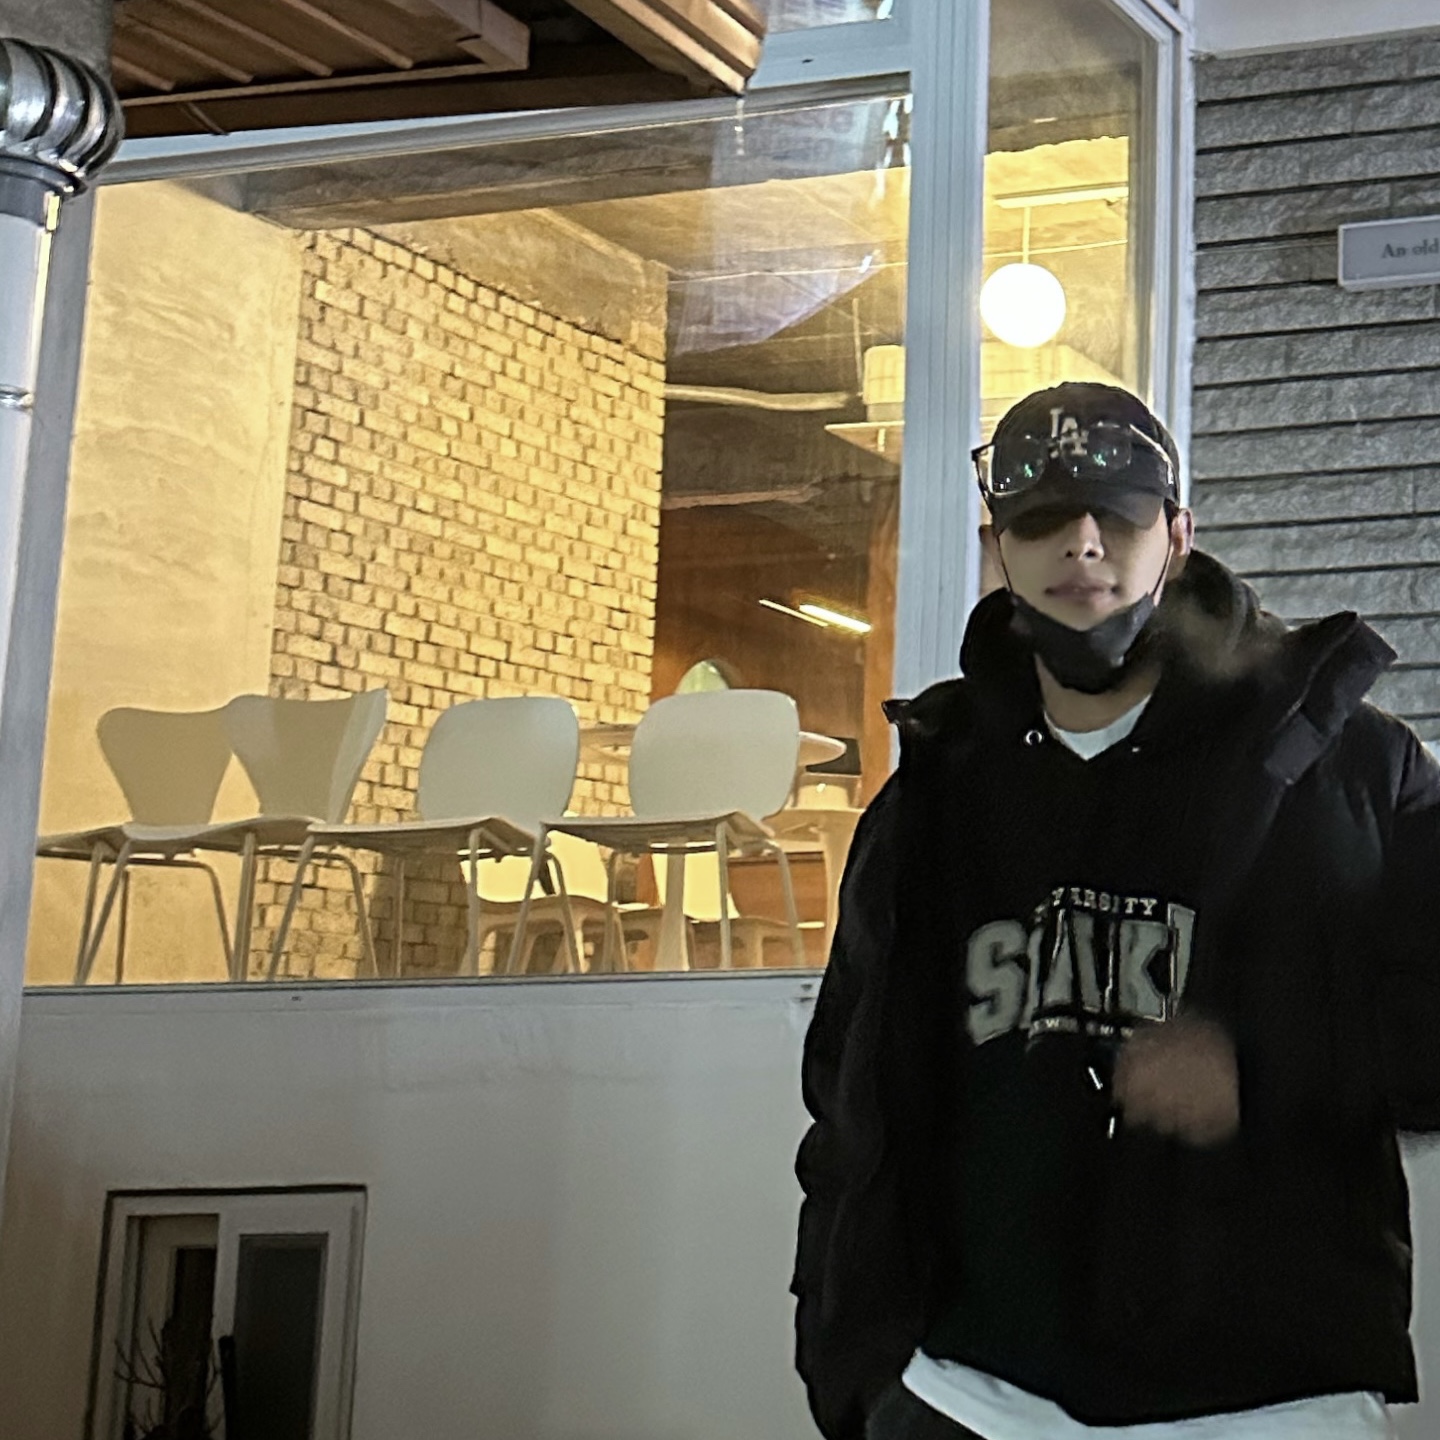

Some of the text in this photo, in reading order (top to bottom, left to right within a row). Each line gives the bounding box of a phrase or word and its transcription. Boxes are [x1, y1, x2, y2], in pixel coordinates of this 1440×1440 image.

[1381, 243, 1406, 259] An
[1412, 238, 1439, 256] old
[1048, 407, 1089, 459] LA
